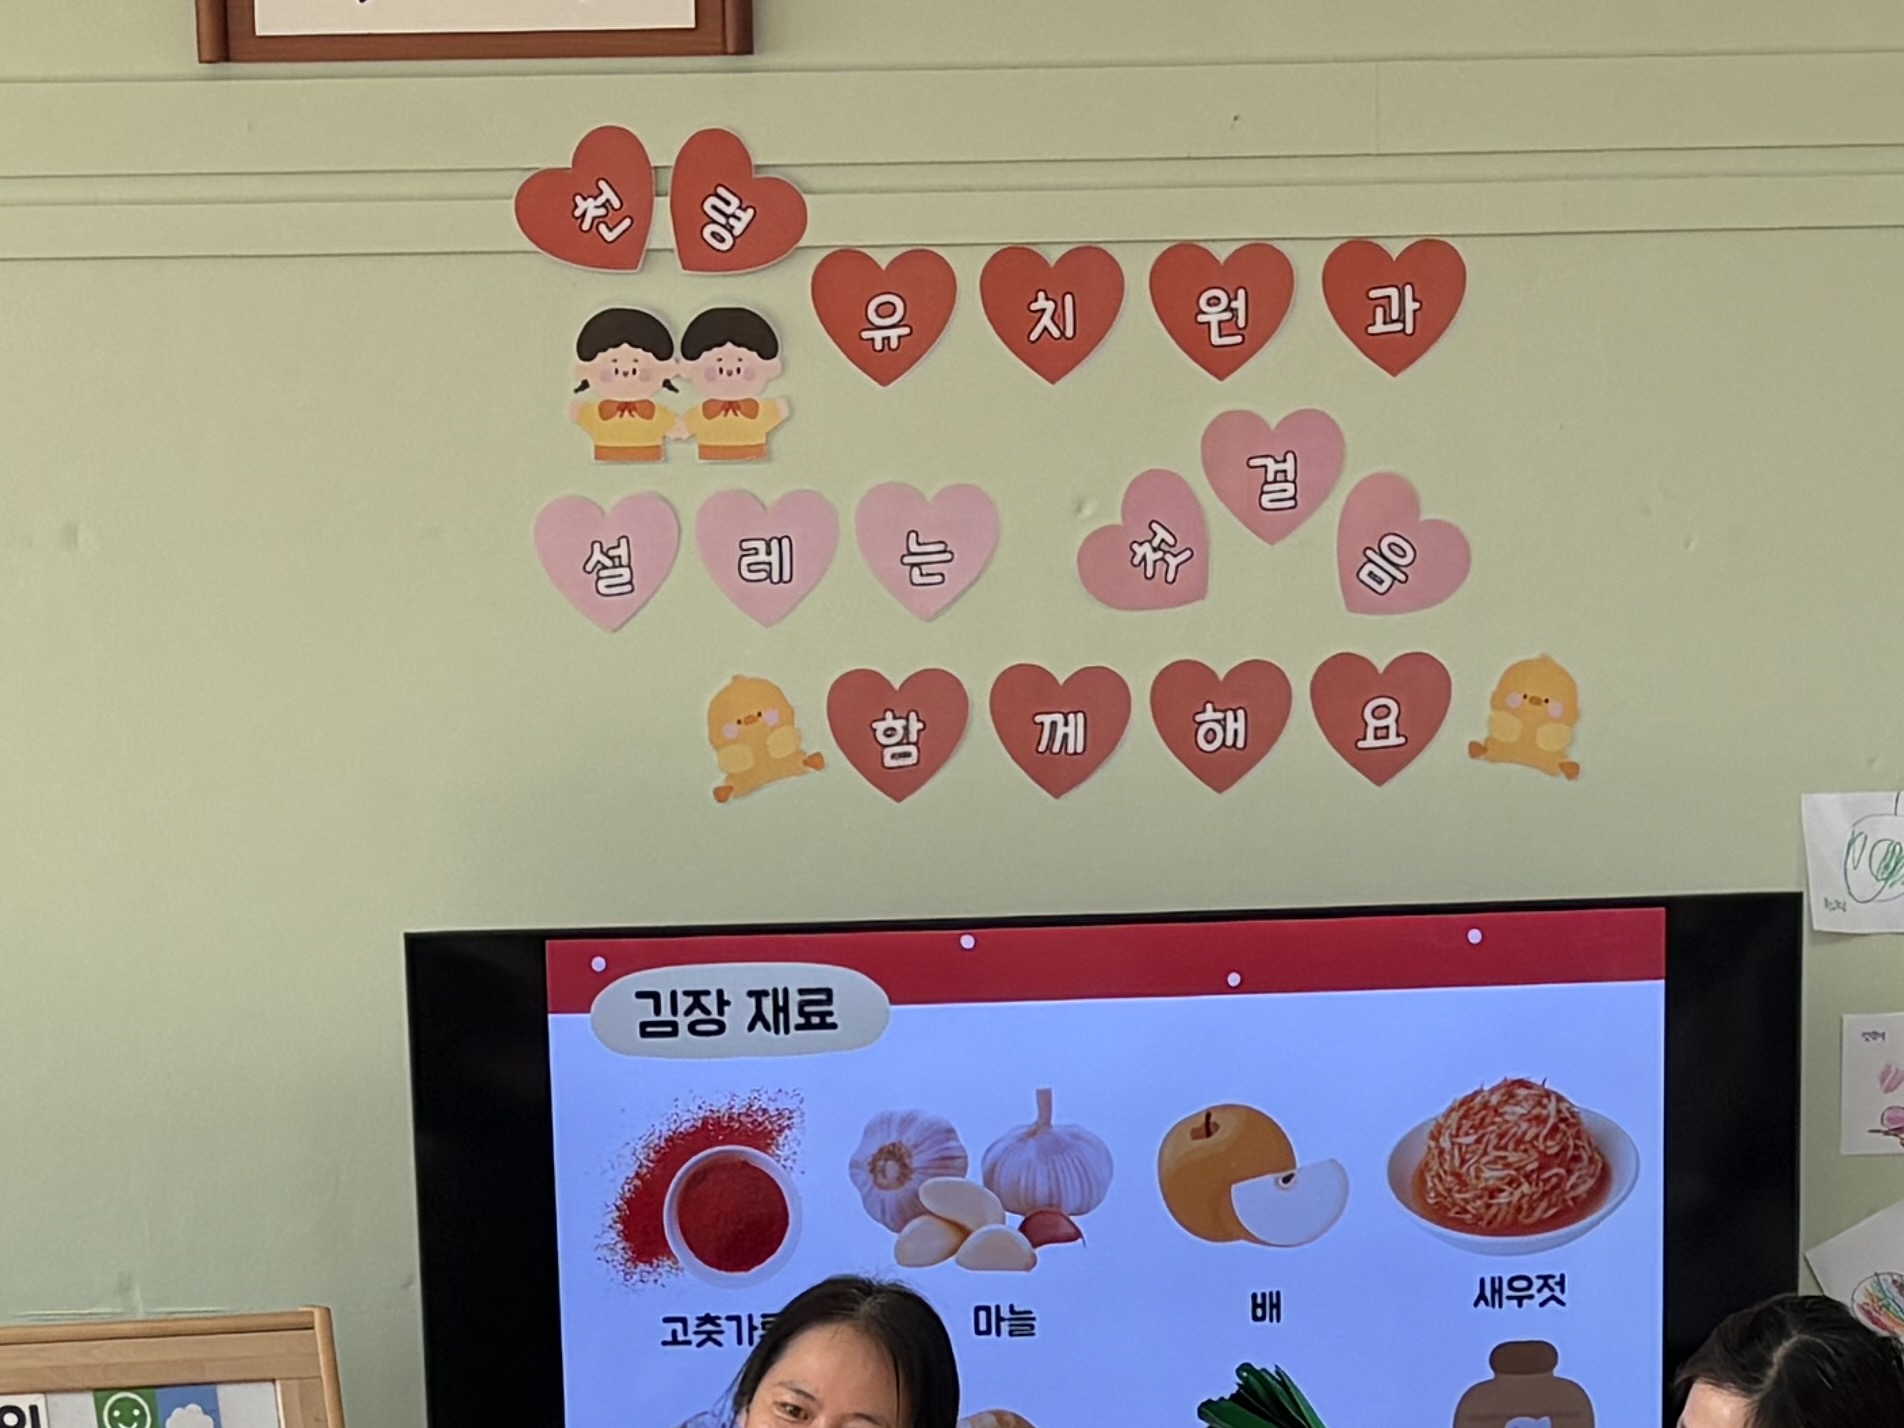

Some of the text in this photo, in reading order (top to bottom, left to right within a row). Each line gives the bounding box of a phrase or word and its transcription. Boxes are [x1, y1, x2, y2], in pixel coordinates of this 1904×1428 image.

[571, 176, 757, 252] 천령
[860, 283, 1421, 350] 유치원과
[582, 531, 954, 596] 설레는
[633, 985, 840, 1040] 김장 재료
[971, 1302, 1039, 1341] 마늘
[1250, 1290, 1283, 1326] 배
[1472, 1273, 1568, 1313] 새우젓
